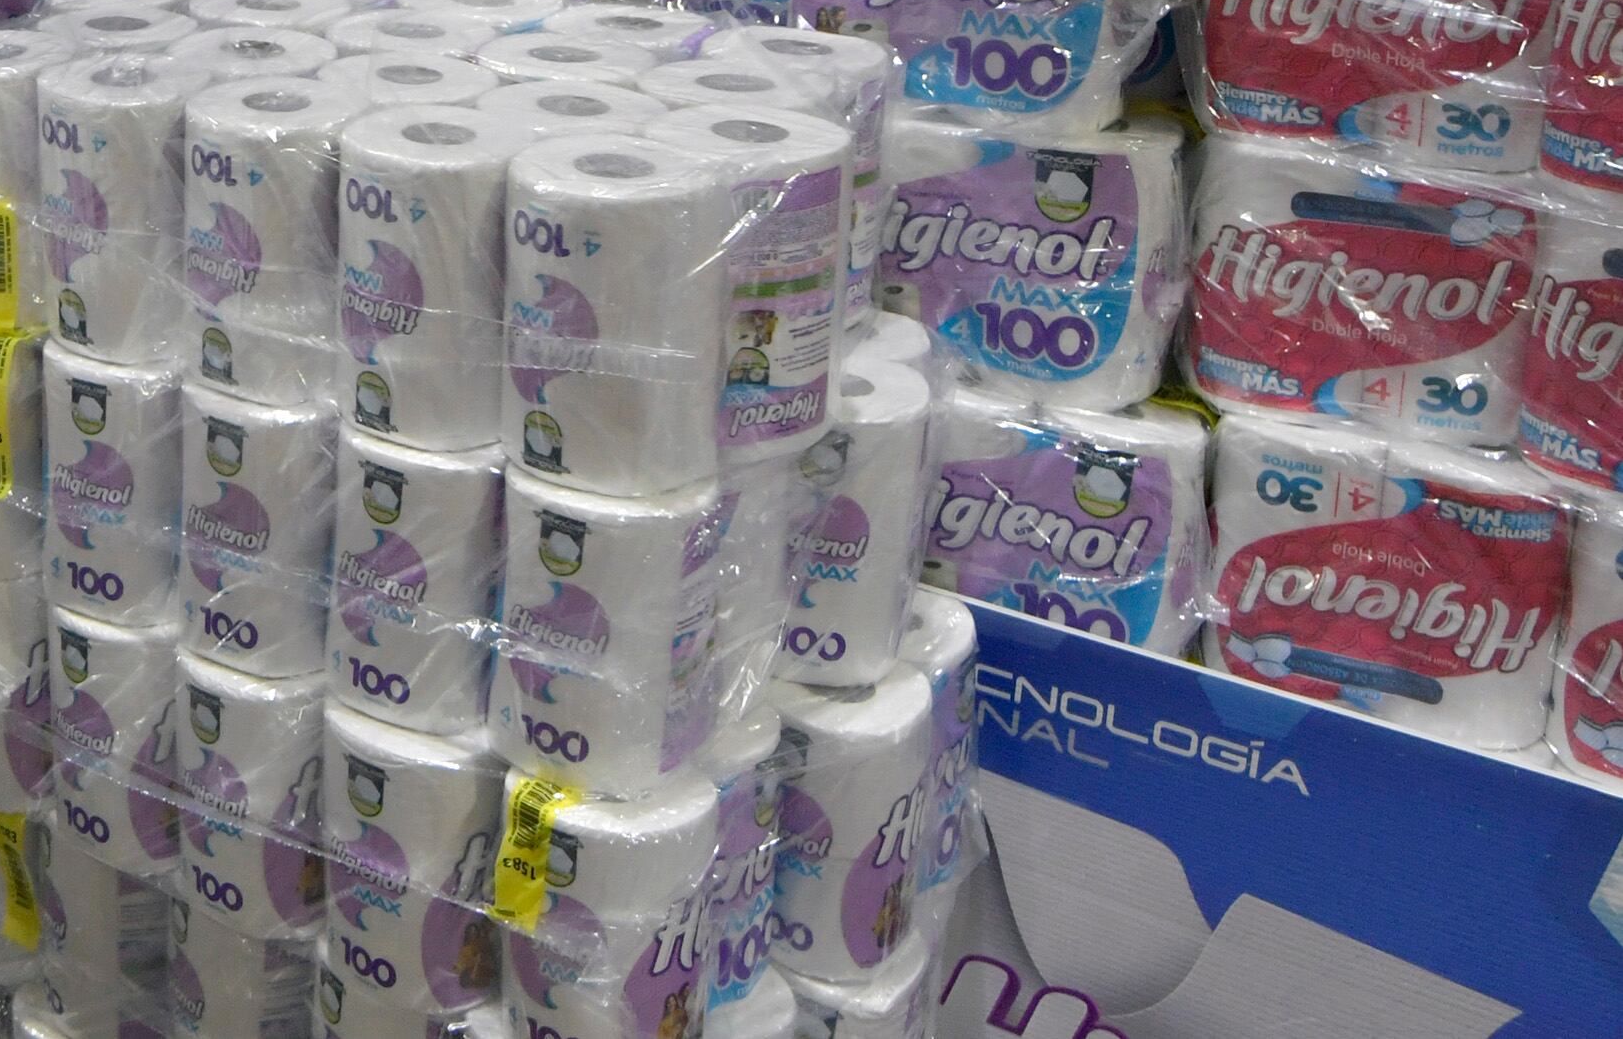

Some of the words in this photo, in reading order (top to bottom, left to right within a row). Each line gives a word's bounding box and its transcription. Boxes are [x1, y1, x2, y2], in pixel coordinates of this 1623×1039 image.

[961, 9, 1055, 42] MAX
[921, 55, 940, 77] 4
[946, 36, 1071, 99] 100
[1331, 43, 1381, 64] Doble
[1385, 53, 1427, 72] Hoja
[1260, 101, 1322, 125] MÁS
[1384, 104, 1412, 126] 4
[1437, 104, 1511, 141] 30
[42, 114, 84, 154] 100
[91, 132, 107, 153] 4
[1437, 143, 1504, 158] metros
[191, 143, 239, 188] 100
[247, 167, 264, 187] 4
[346, 177, 399, 224] 100
[407, 197, 427, 224] 4
[513, 209, 571, 258] 100
[583, 232, 602, 257] 4
[1208, 225, 1513, 325] Higienol
[342, 287, 420, 336] Higienol
[989, 276, 1086, 314] MAX
[950, 315, 972, 337] 4
[977, 302, 1095, 369] 100
[1312, 319, 1361, 340] Doble
[1242, 370, 1301, 397] MÁS
[1363, 377, 1391, 399] 4
[1414, 375, 1489, 417] 30
[729, 386, 821, 439] Higienol
[1261, 453, 1323, 475] metros
[1542, 433, 1601, 465] MÁS
[52, 464, 133, 507] Higienol
[1256, 469, 1323, 513] 30
[1348, 485, 1376, 513] 4
[187, 506, 270, 553] Higienol
[1440, 499, 1502, 533] MÁS
[1332, 541, 1375, 563] Hoja
[1381, 552, 1426, 577] Doble
[67, 562, 124, 602] 100
[339, 550, 426, 605] Higienol
[806, 562, 859, 584] MAX
[199, 605, 259, 650] 100
[1236, 556, 1541, 674] Higienol
[348, 655, 411, 705] 100
[521, 714, 591, 763] 100
[977, 662, 1311, 797] CNOLOGÍA
[978, 702, 1110, 768] NAL
[64, 798, 111, 843] 100
[192, 864, 244, 912] 100
[502, 857, 537, 881] 1583
[352, 886, 402, 917] MAX
[341, 937, 397, 989] 100
